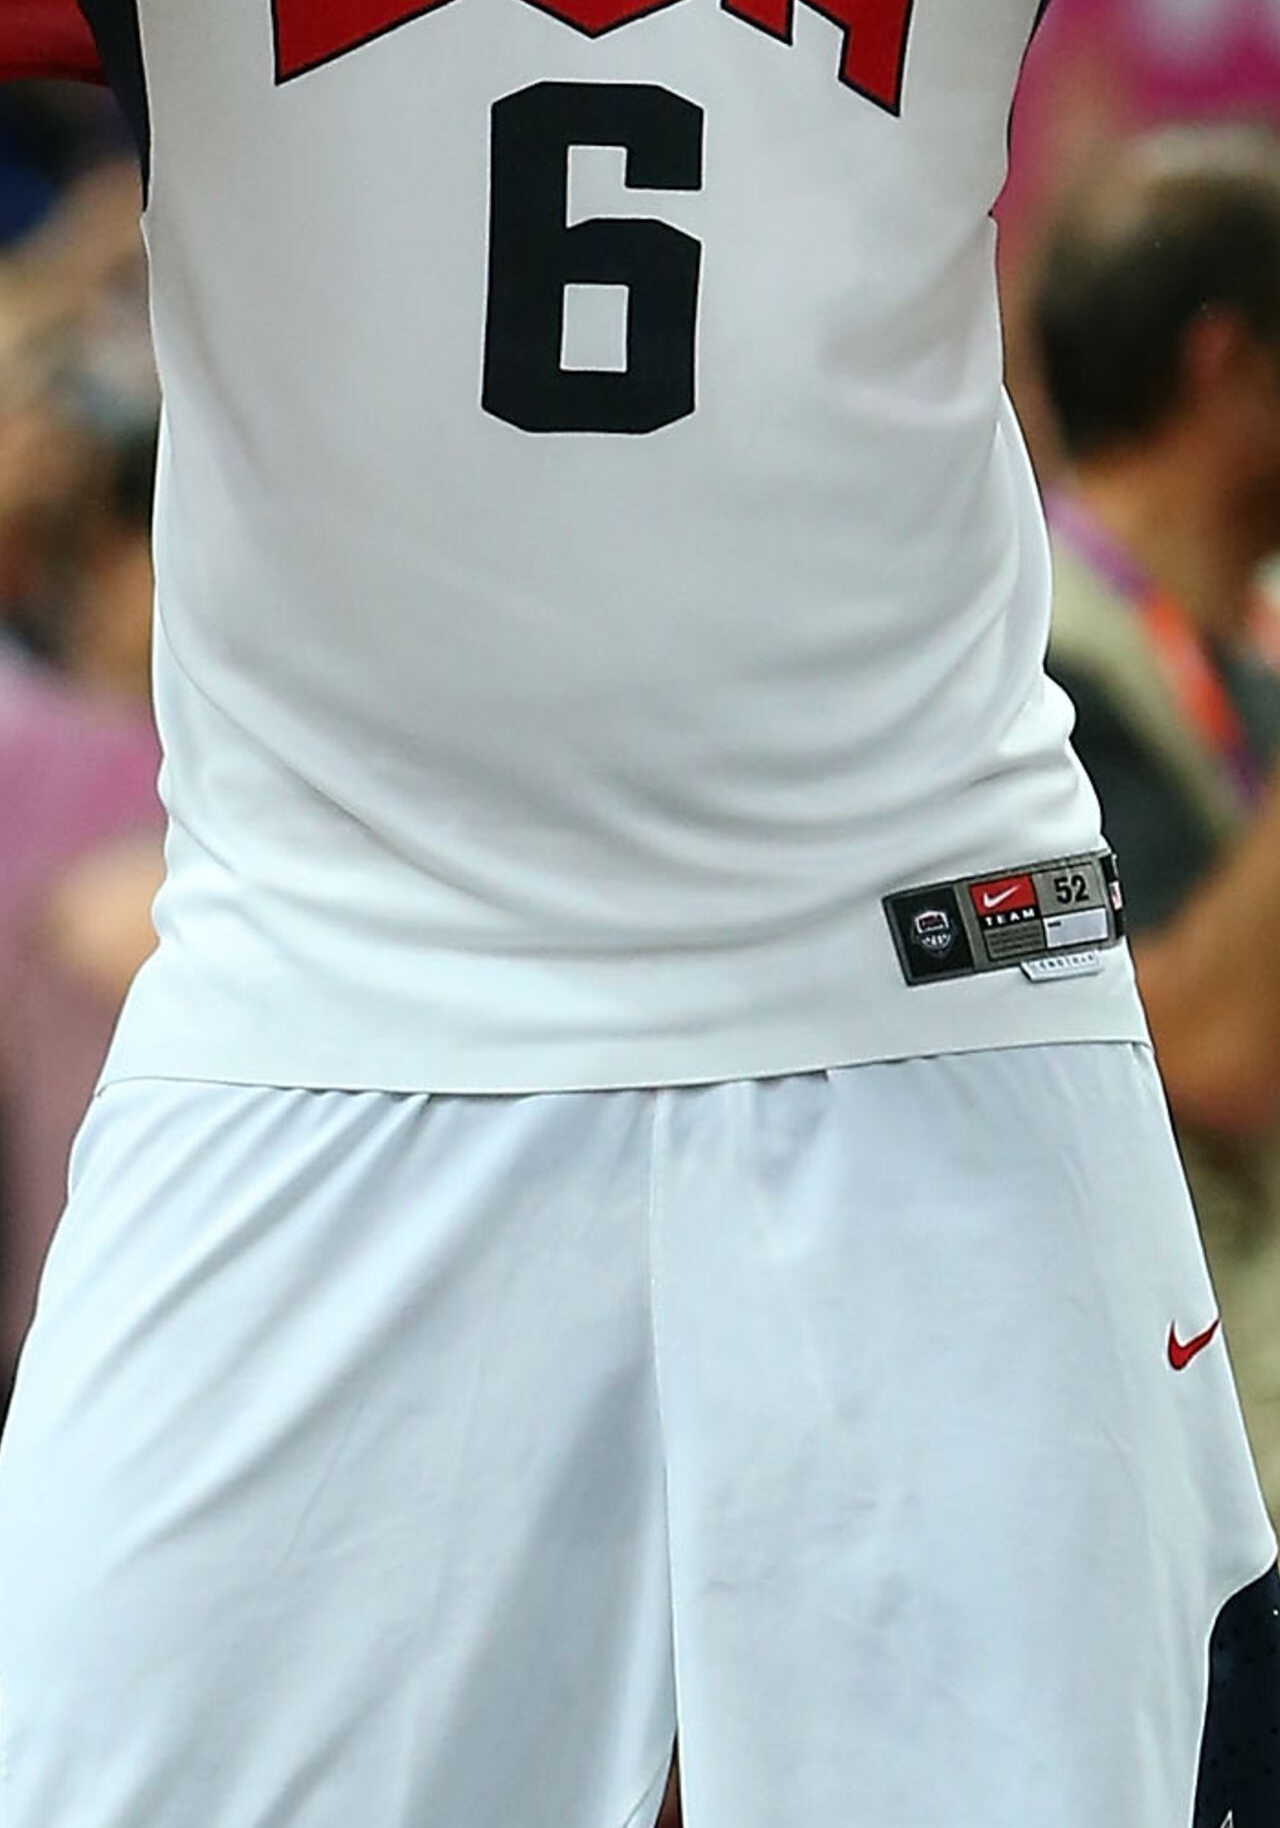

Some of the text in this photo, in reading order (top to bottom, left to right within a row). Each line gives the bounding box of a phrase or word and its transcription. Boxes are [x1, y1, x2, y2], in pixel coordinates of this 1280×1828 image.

[481, 80, 705, 434] 6
[1054, 874, 1090, 904] 52
[985, 908, 1036, 927] TEAM
